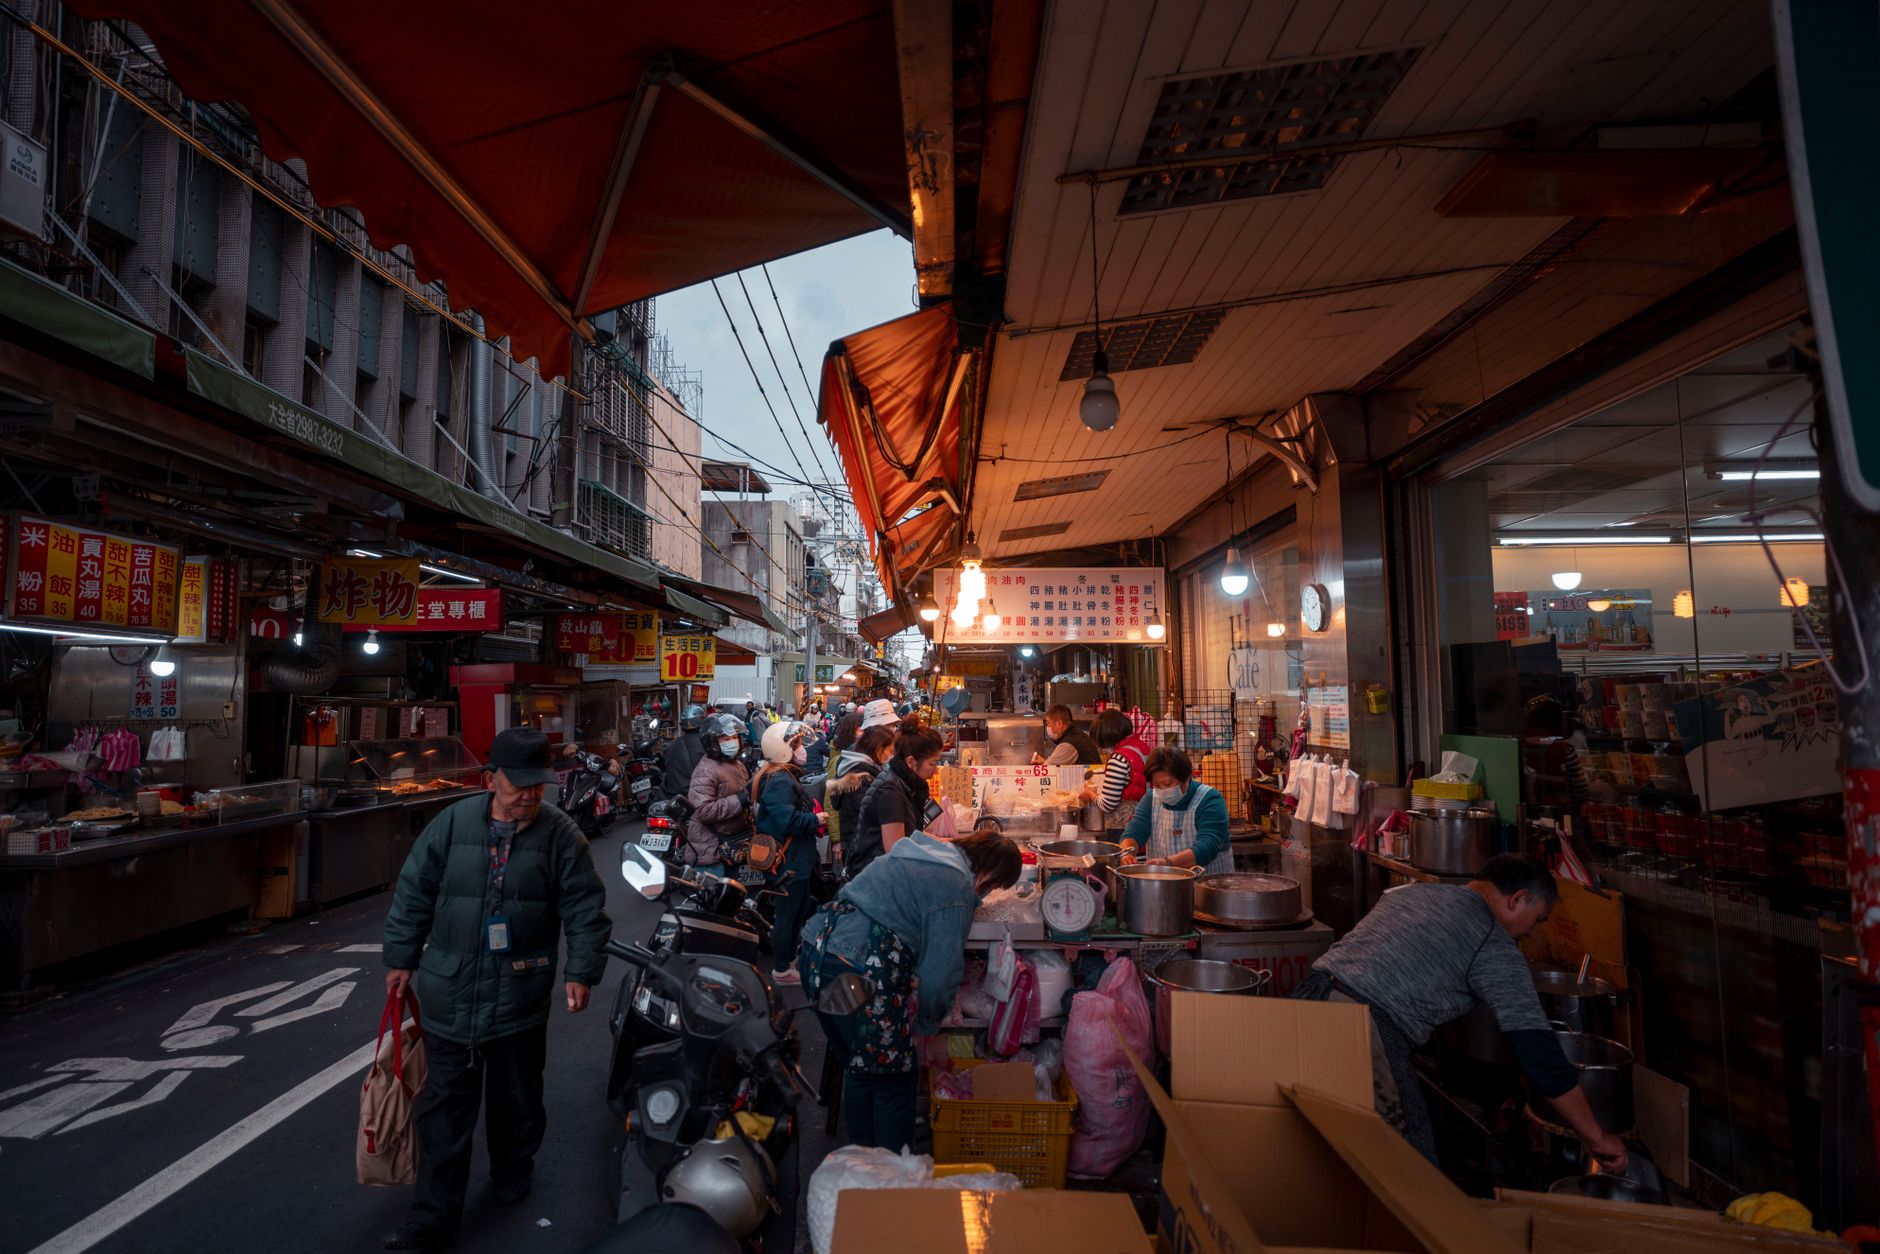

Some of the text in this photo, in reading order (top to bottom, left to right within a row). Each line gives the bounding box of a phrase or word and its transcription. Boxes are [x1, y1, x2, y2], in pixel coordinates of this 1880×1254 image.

[17, 526, 46, 611] 米粉 35
[49, 530, 75, 615] 油飯 35
[78, 538, 104, 618] 貢丸湯 40
[105, 542, 128, 603] 甜不辣
[131, 547, 153, 606] 苦瓜丸
[157, 551, 177, 597] 甜不辣
[183, 566, 200, 605] 甜不辣
[322, 566, 416, 620] 炸物
[1030, 585, 1040, 626] 四神湯
[619, 614, 654, 630] 百貨
[664, 638, 713, 652] 生活百貨
[664, 653, 697, 677] 10
[160, 707, 176, 717] 50
[1033, 765, 1048, 777] 65
